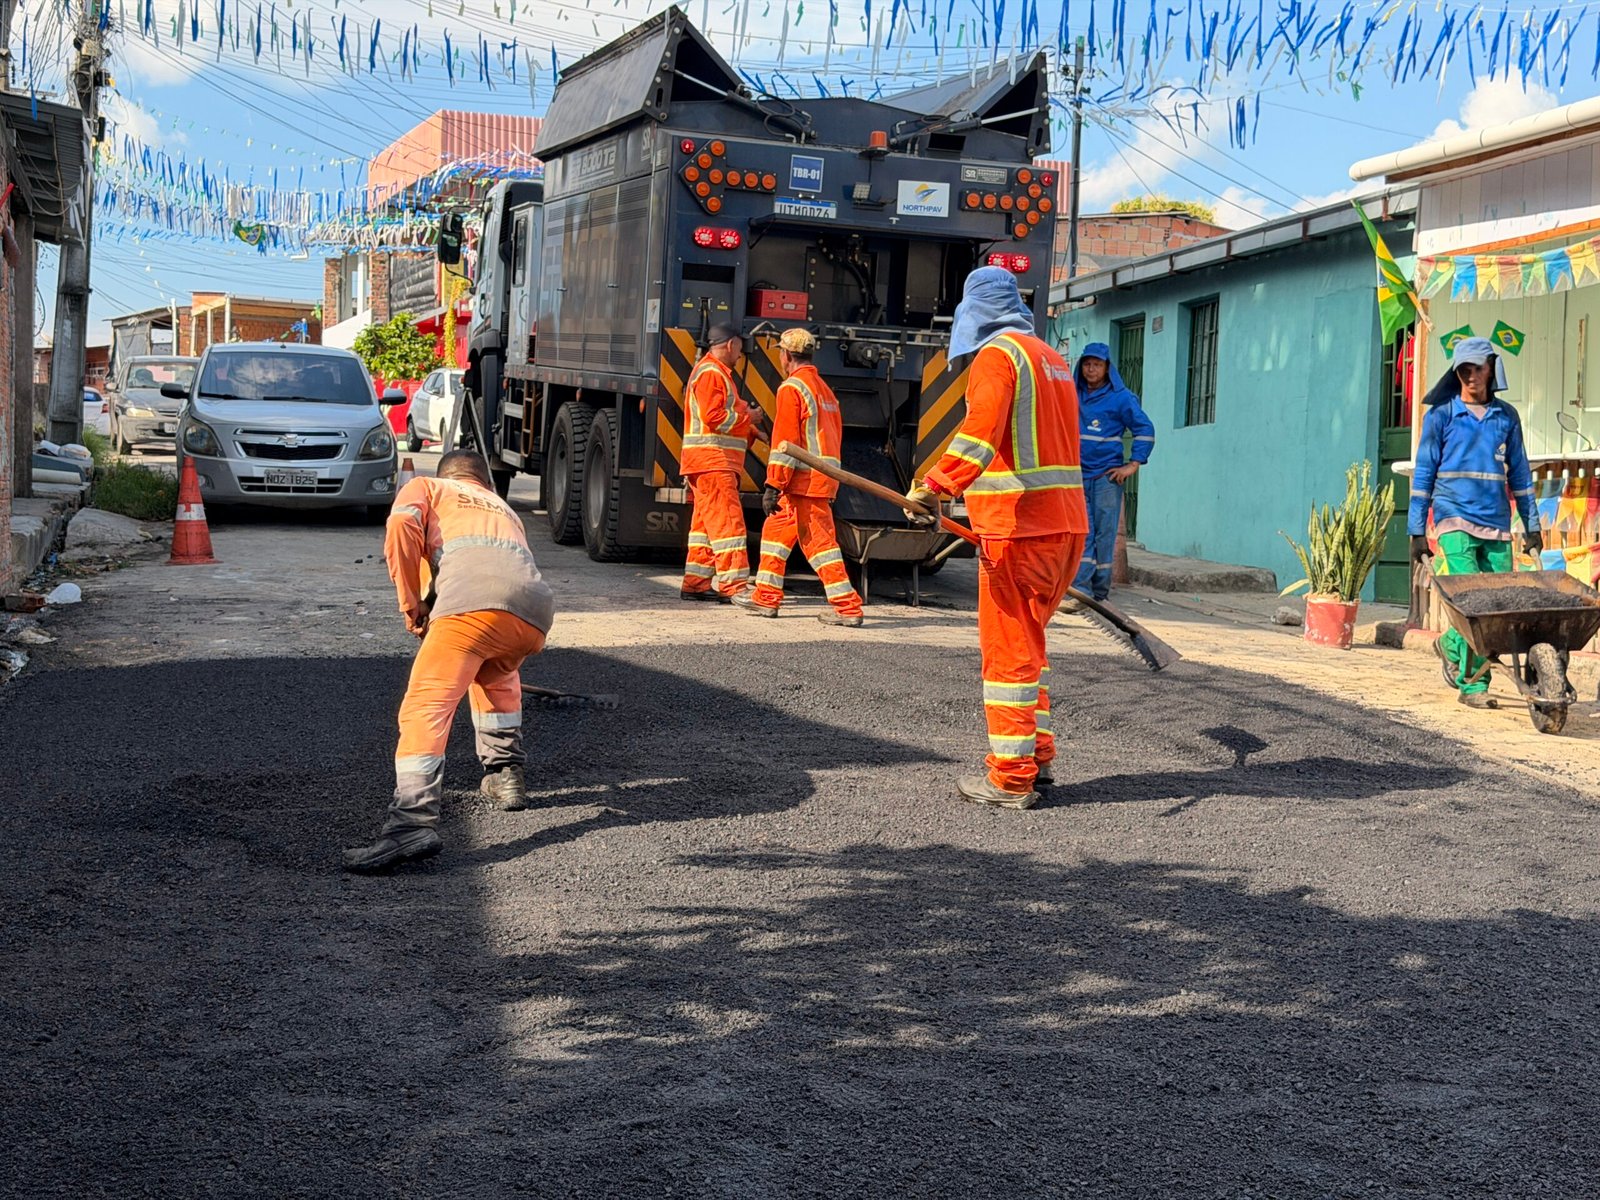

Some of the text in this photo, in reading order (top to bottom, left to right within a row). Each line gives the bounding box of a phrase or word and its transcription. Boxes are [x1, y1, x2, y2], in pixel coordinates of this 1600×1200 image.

[793, 167, 820, 180] TBR-01
[965, 169, 976, 178] SR
[902, 204, 943, 213] NORTHPAV
[646, 511, 680, 531] SR
